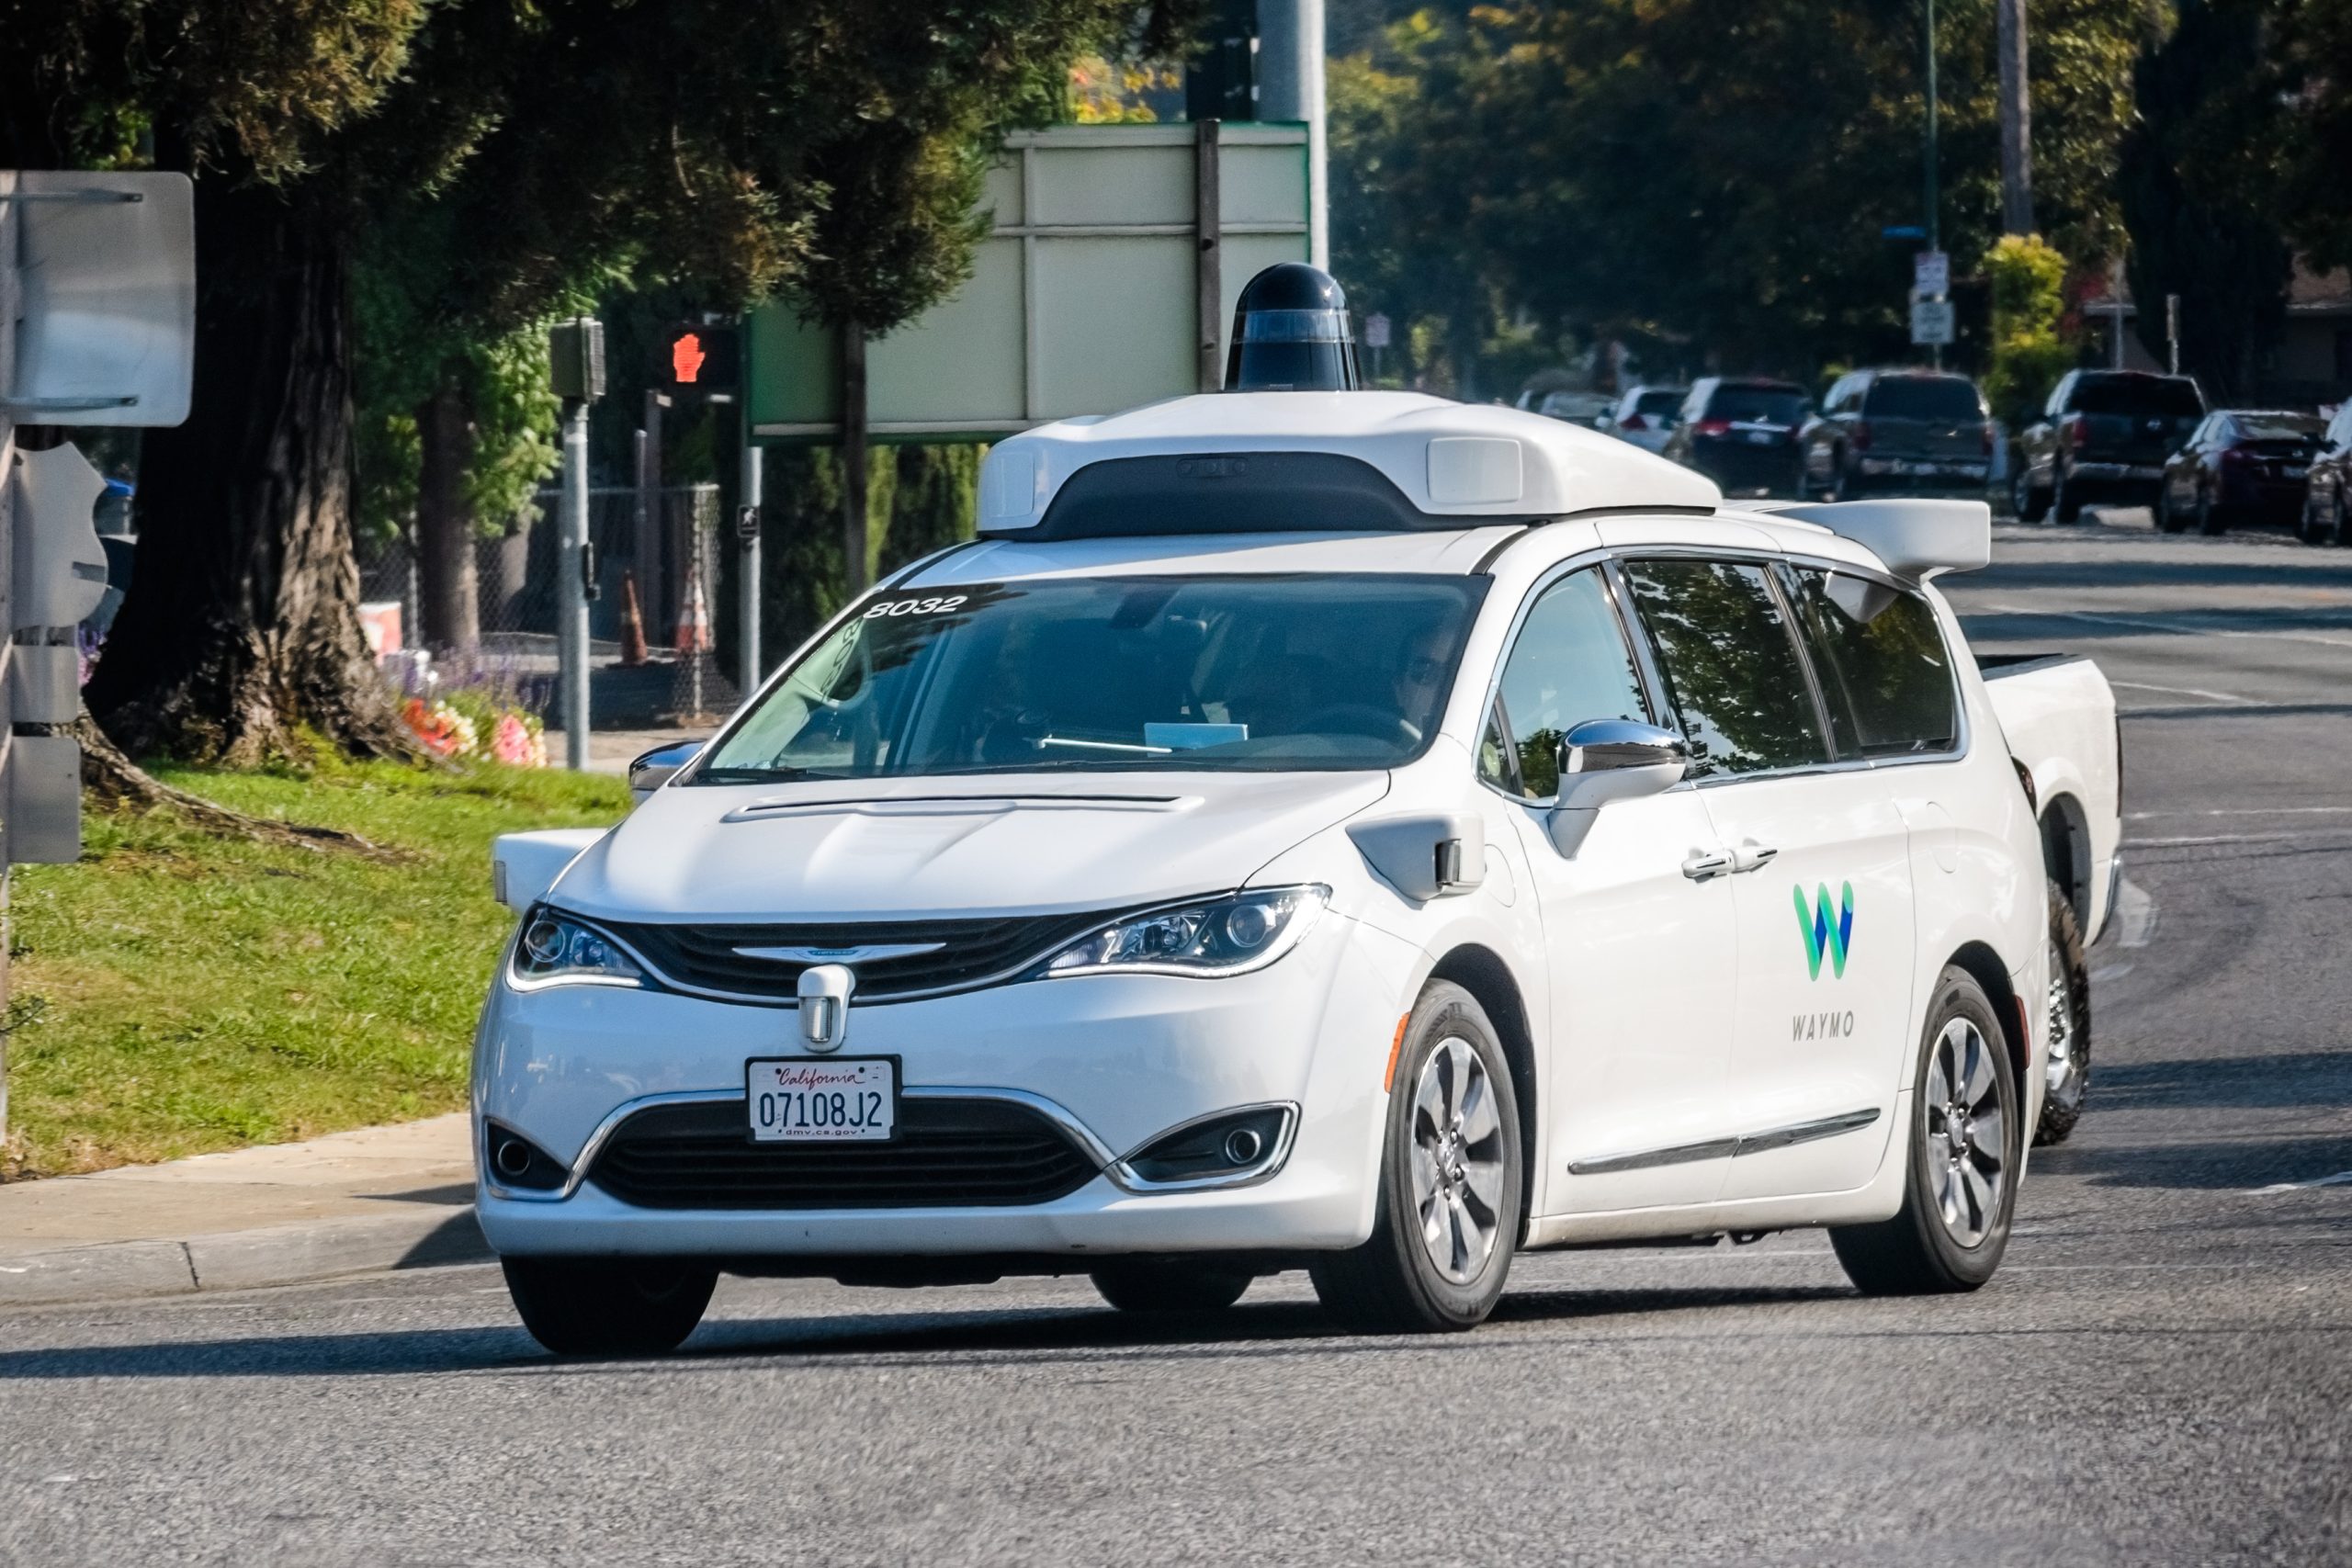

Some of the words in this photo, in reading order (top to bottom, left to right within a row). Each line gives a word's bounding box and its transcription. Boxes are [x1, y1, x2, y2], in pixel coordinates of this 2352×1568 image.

[863, 595, 968, 619] 8032
[1792, 1010, 1854, 1043] WAYMO
[779, 1067, 865, 1090] California
[759, 1091, 883, 1128] 07108J2
